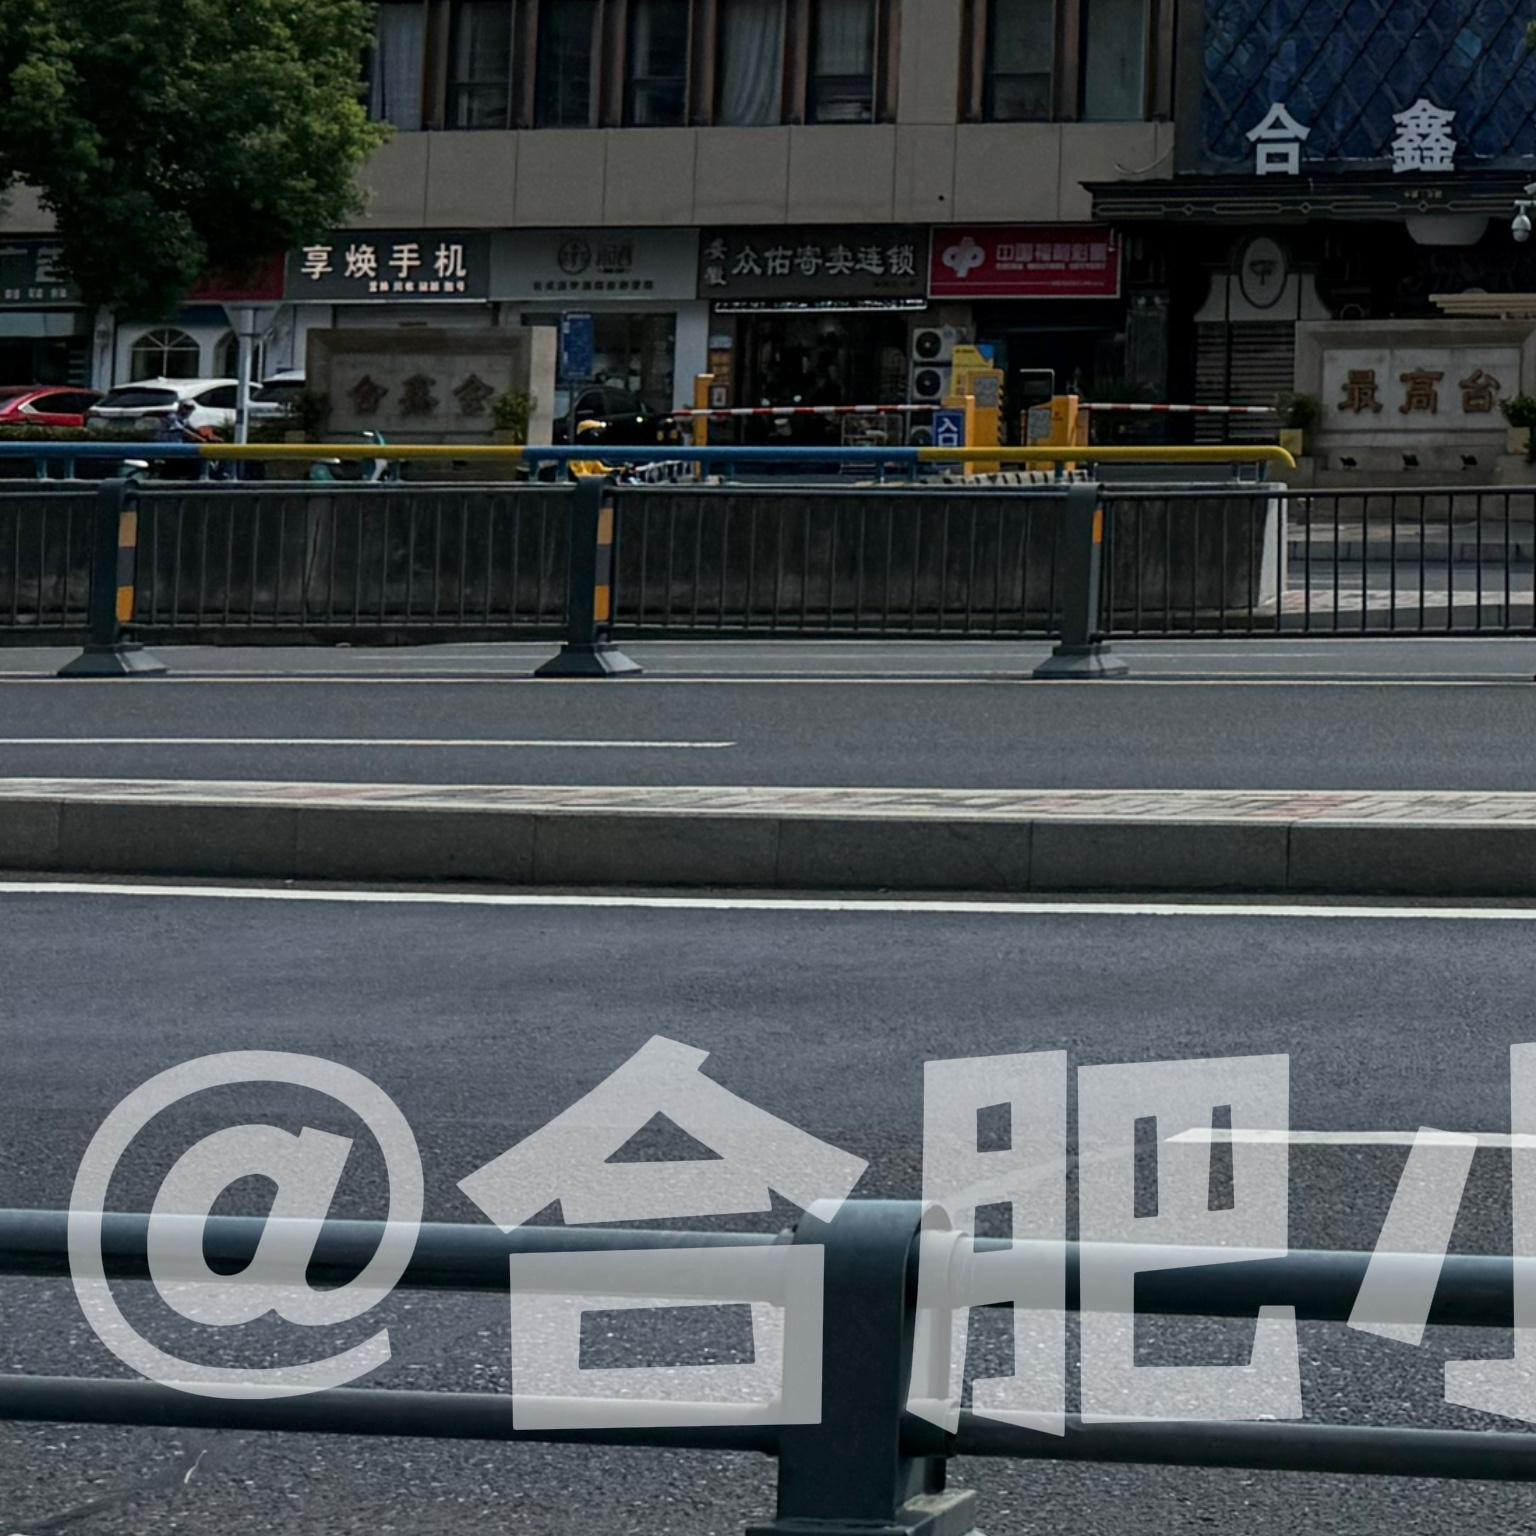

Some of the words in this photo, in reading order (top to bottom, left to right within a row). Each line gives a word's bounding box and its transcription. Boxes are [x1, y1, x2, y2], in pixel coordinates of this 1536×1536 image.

[300, 242, 467, 280] 享焕手机
[730, 243, 916, 278] 众佑寄卖连锁
[1338, 367, 1502, 417] 最高台
